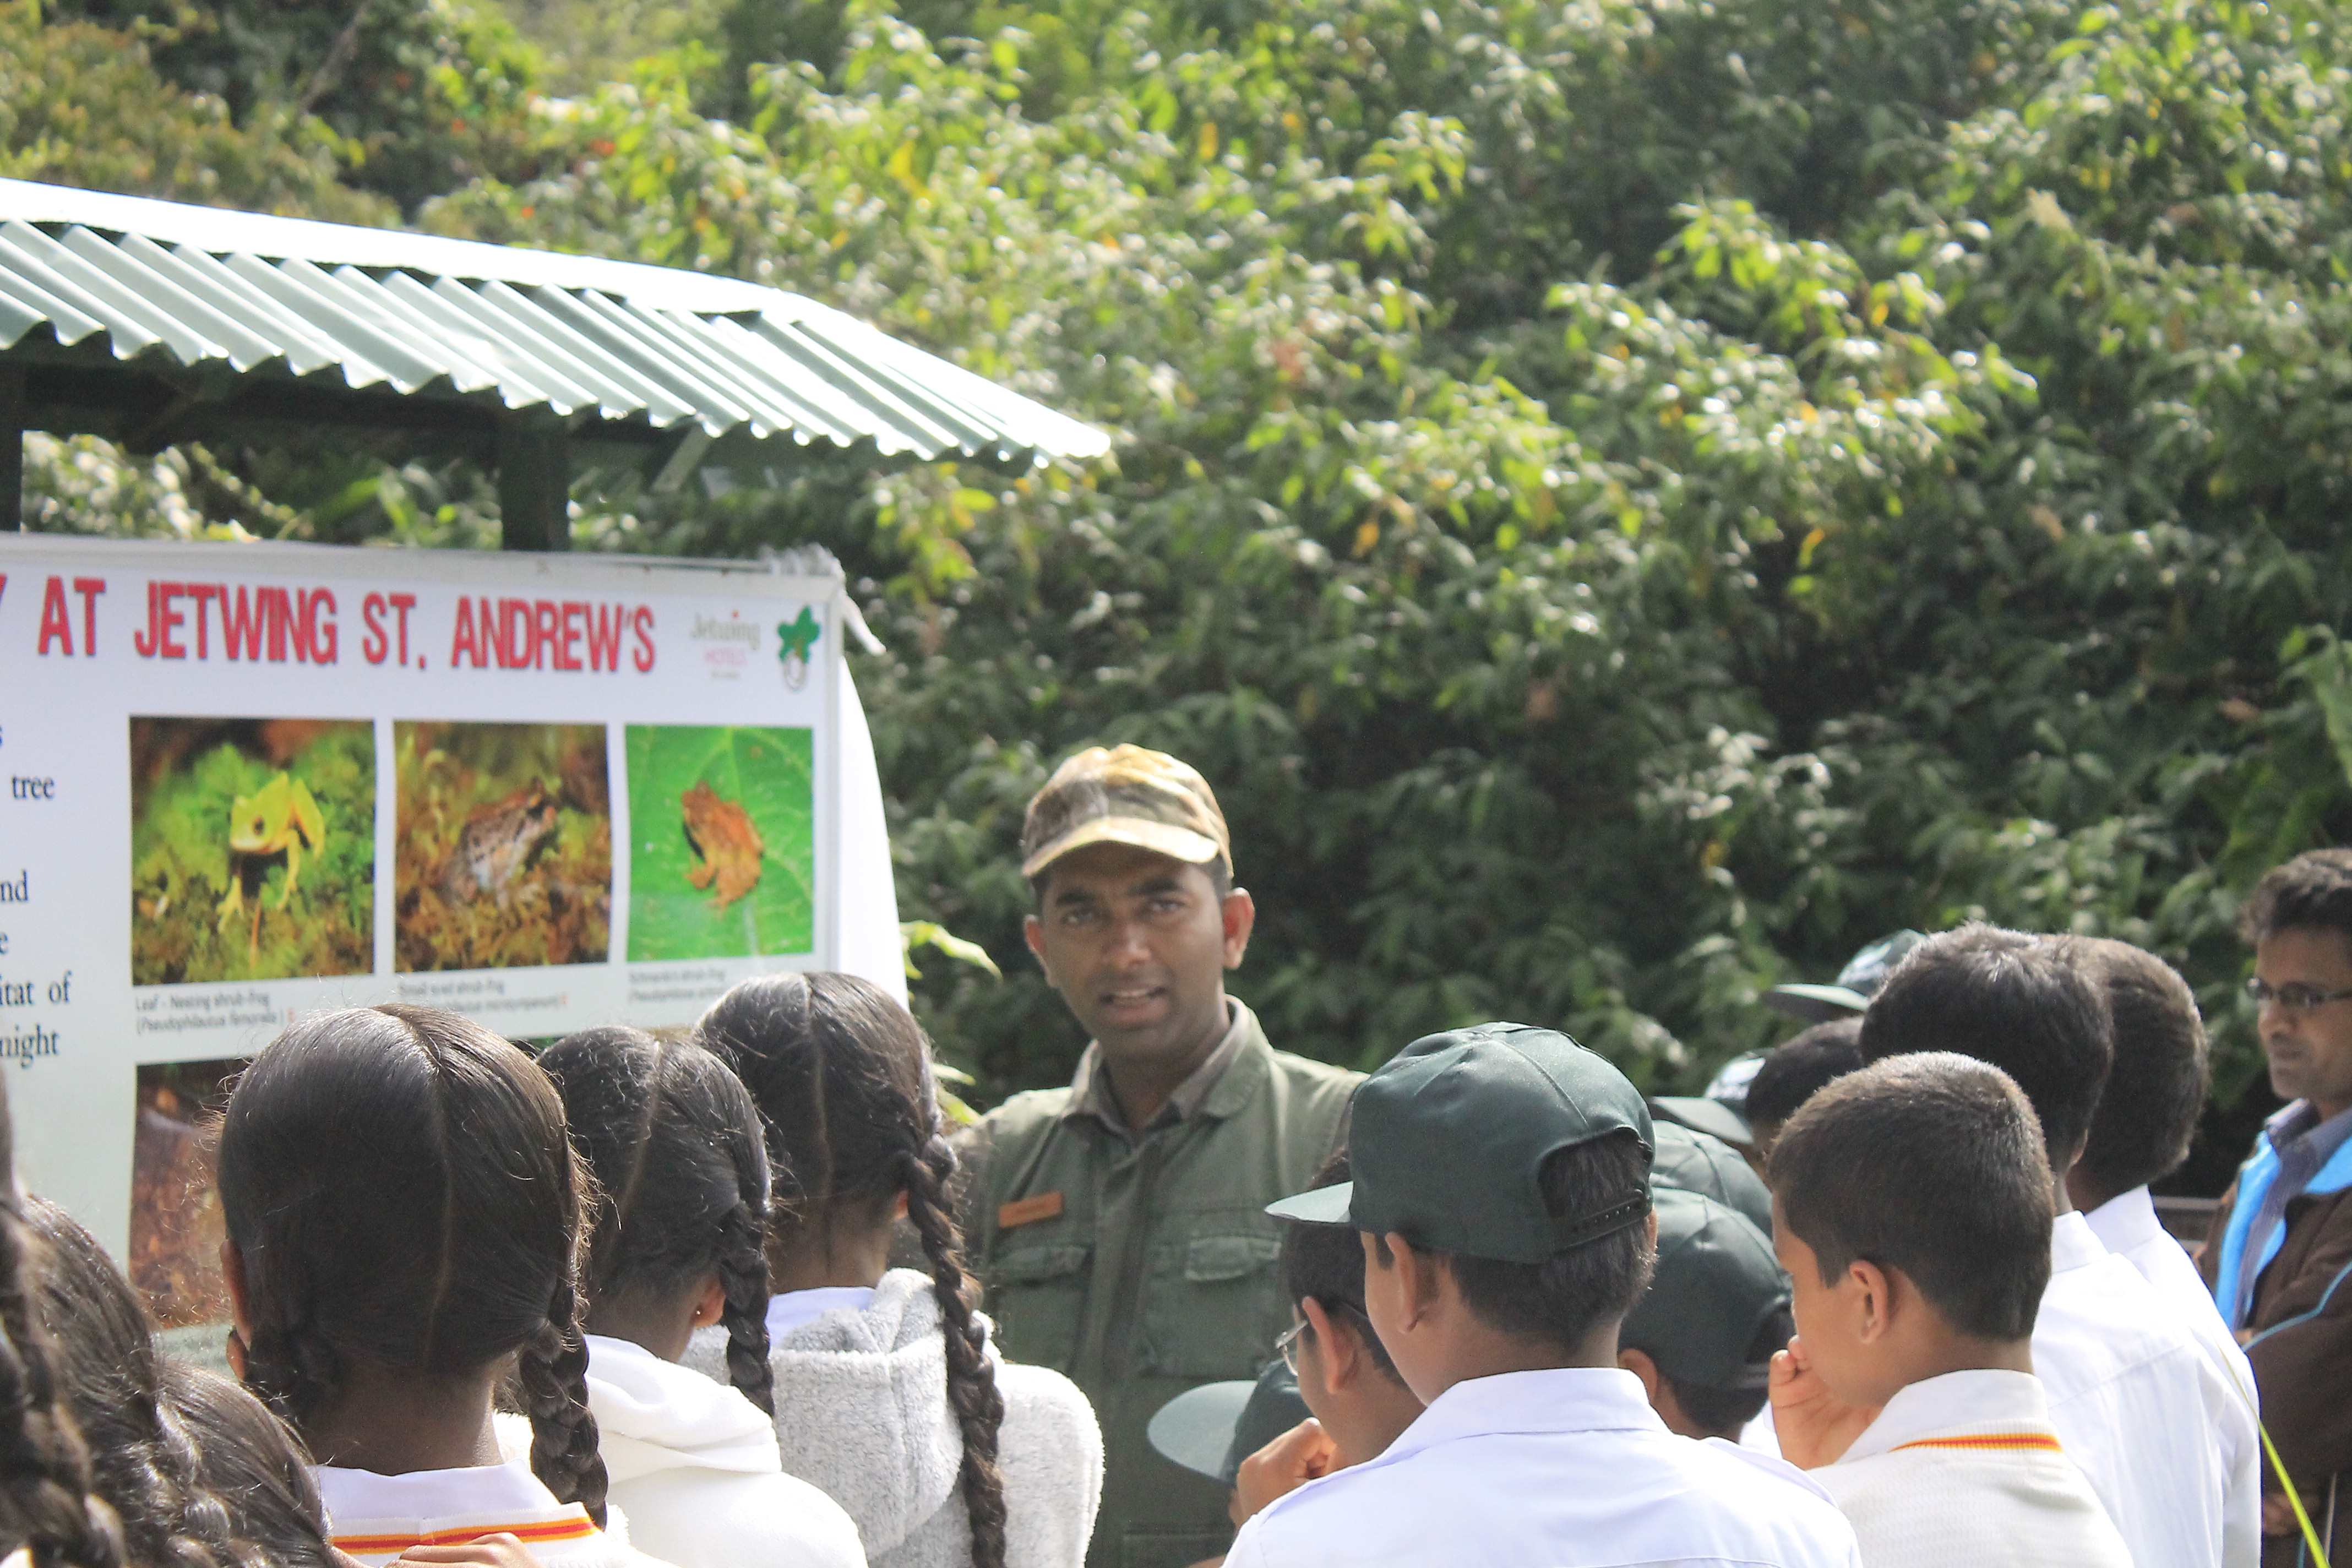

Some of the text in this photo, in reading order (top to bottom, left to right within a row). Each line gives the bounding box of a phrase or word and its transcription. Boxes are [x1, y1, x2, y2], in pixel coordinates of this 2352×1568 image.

[37, 575, 107, 657] AT
[134, 580, 338, 666] JETWING
[362, 591, 426, 671] ST.
[451, 596, 655, 673] ANDREW'S
[12, 775, 55, 800] tree
[48, 970, 72, 1004] of
[0, 1023, 59, 1068] night
